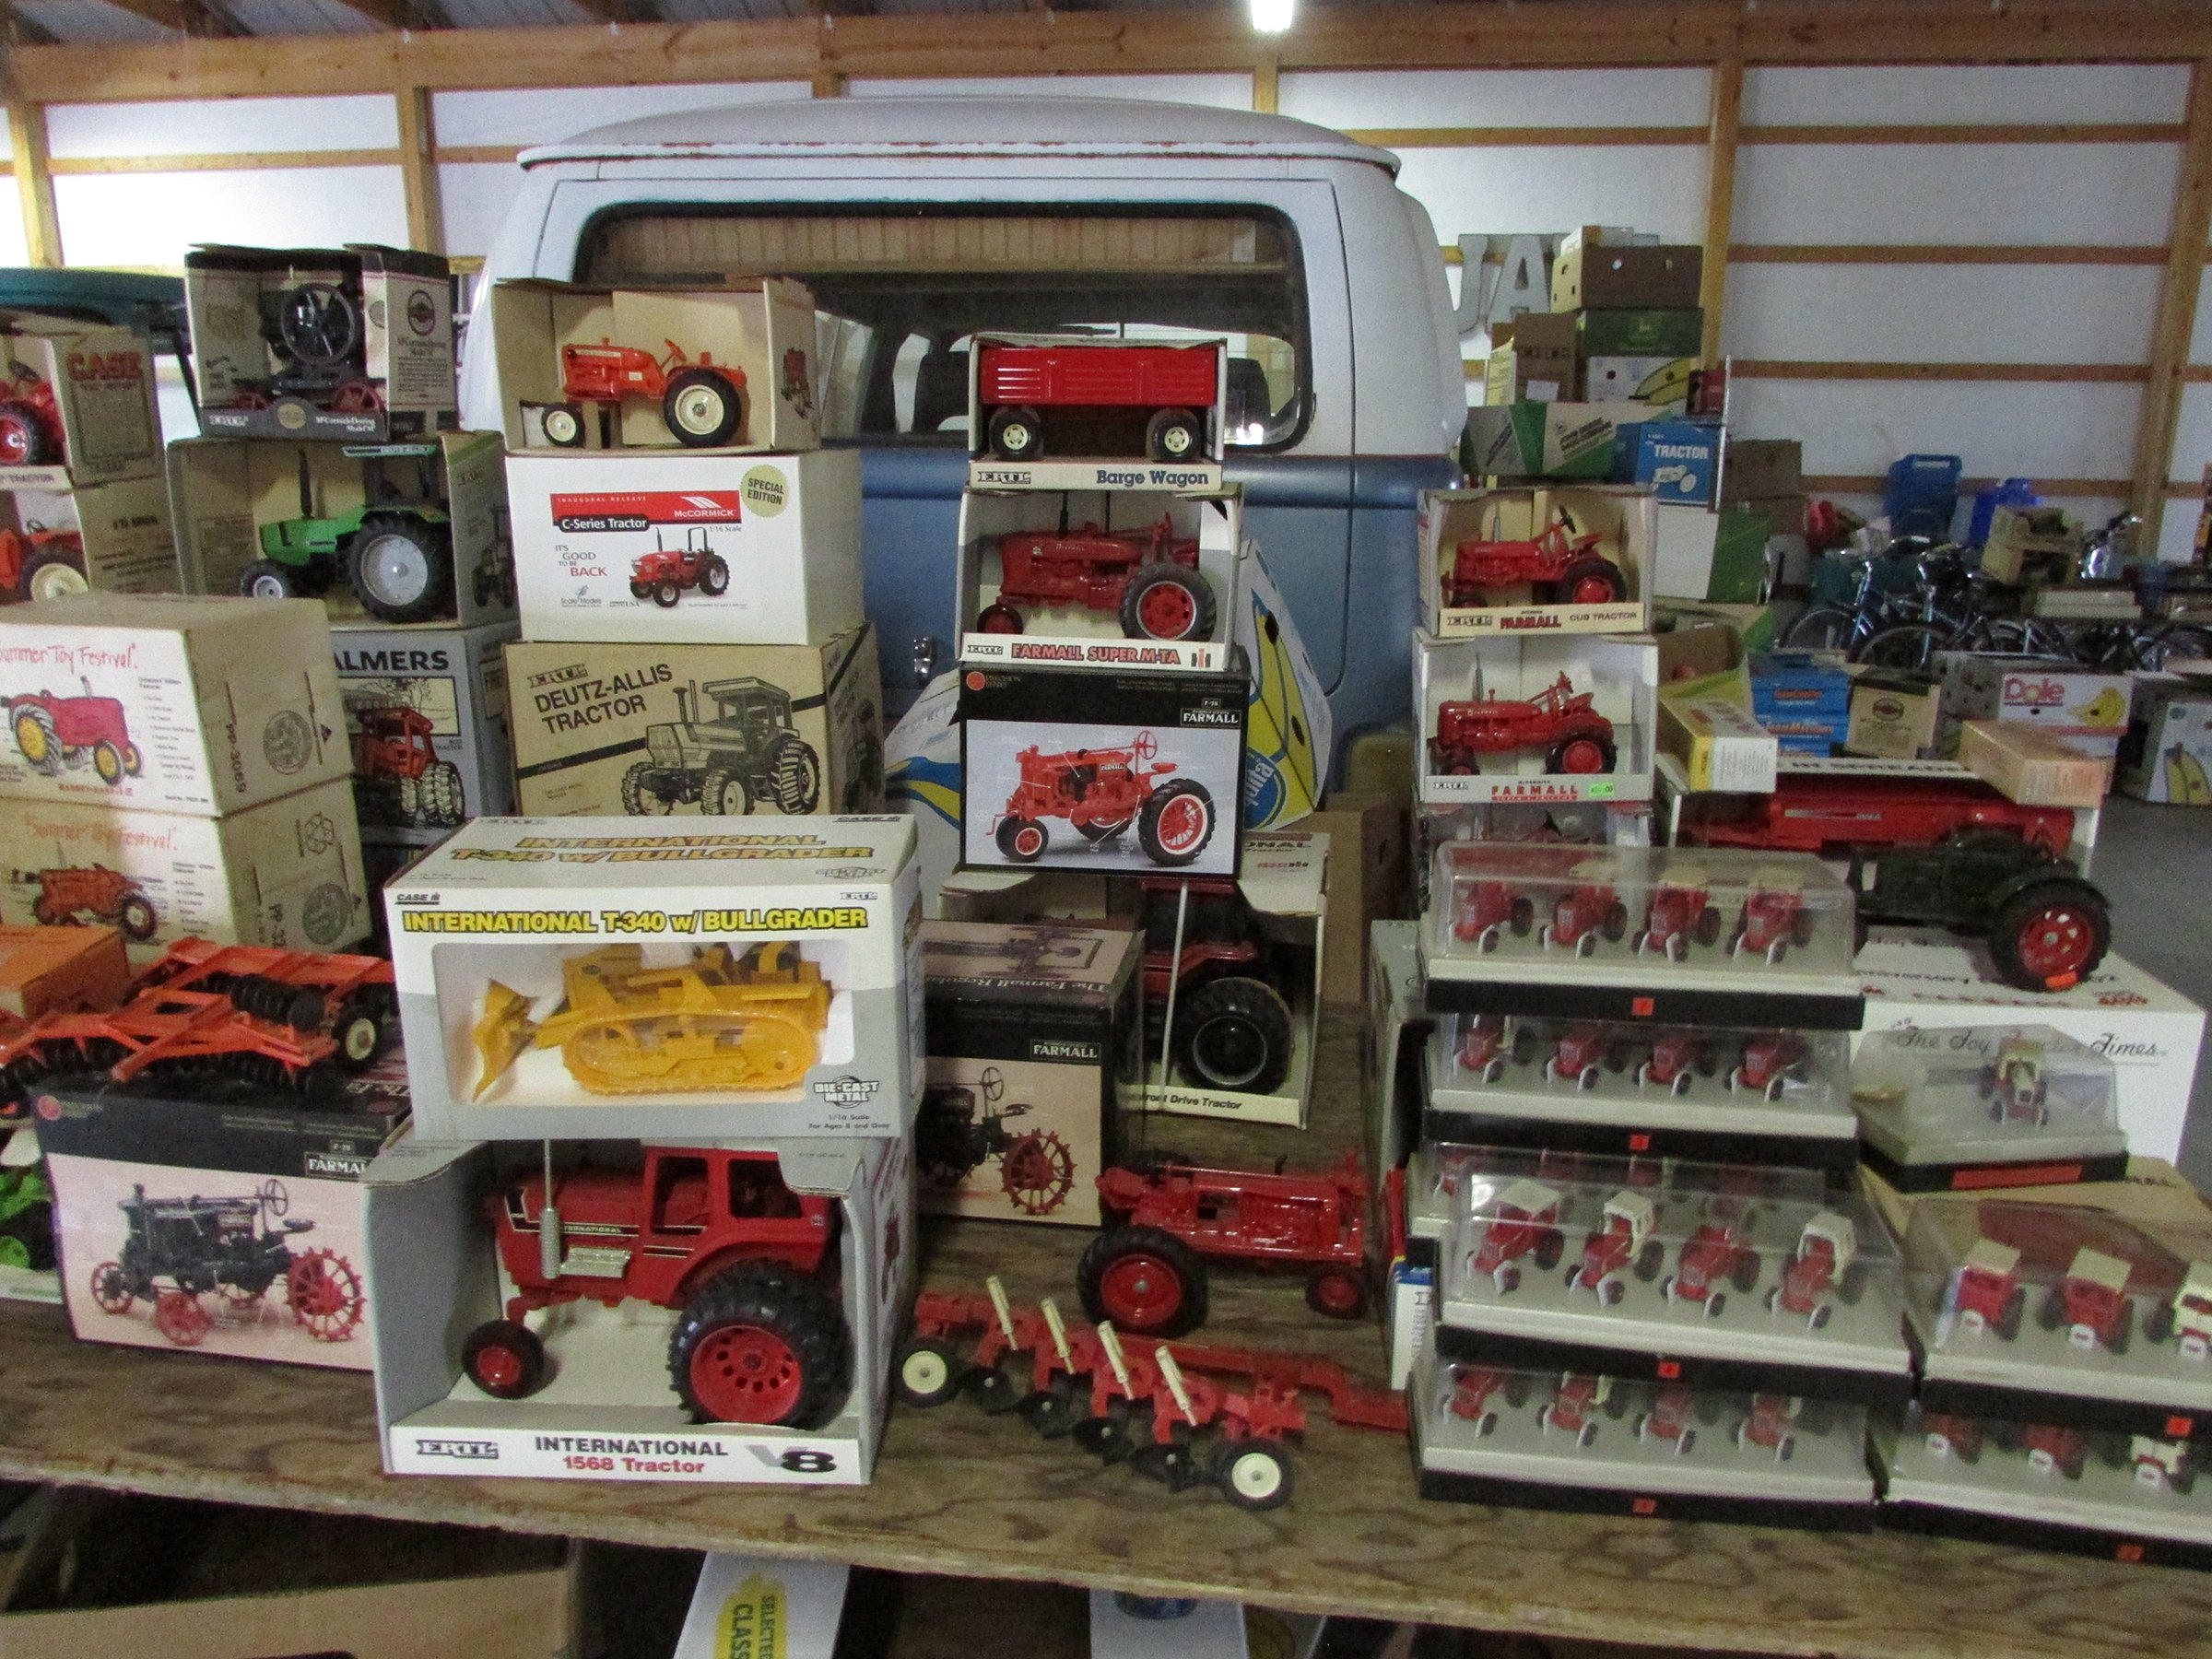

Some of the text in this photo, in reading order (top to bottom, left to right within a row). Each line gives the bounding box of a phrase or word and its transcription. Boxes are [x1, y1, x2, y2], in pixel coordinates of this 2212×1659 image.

[1653, 443, 1709, 459] TRACTOR
[747, 477, 784, 495] SPECIAL
[977, 470, 1209, 488] ERTL Barge Wagon
[747, 488, 782, 505] EDITION
[561, 518, 647, 530] C-Series Tractor
[562, 552, 596, 560] GOOD
[571, 566, 608, 577] BACK
[1500, 615, 1562, 629] FARMALL
[1570, 613, 1590, 622] CUB
[1593, 611, 1638, 621] TRACTOR
[47, 645, 76, 675] Toy
[967, 644, 1004, 655] ERTL
[1011, 643, 1085, 661] FARMALL
[1087, 645, 1140, 663] SUPER
[1139, 648, 1182, 665] M-TA
[534, 663, 673, 713] DEUTZ-ALLIS
[2004, 677, 2066, 702] Dole
[542, 694, 647, 735] TRACTOR
[1182, 712, 1239, 724] FARMALL
[1490, 784, 1579, 796] FARMALL
[515, 835, 827, 849] INTERNATIONAL
[450, 847, 875, 864] T-340 w/ BULLGRADER
[396, 893, 428, 901] CASE
[840, 892, 877, 900] ERTL
[402, 907, 869, 935] INTERNATIONAL T-340 w/ BULLGRADER
[1033, 1044, 1098, 1059] FARMALL
[2090, 1032, 2159, 1057] Times
[814, 1080, 880, 1094] DIE-CAST
[824, 1091, 870, 1103] METAL
[1170, 1094, 1199, 1106] Drive
[1201, 1097, 1242, 1110] Tractor
[308, 1158, 369, 1174] FARMA
[416, 1436, 728, 1460] ERTL INTERNATIONAL
[563, 1455, 615, 1472] 1568
[625, 1456, 706, 1475] Tractor
